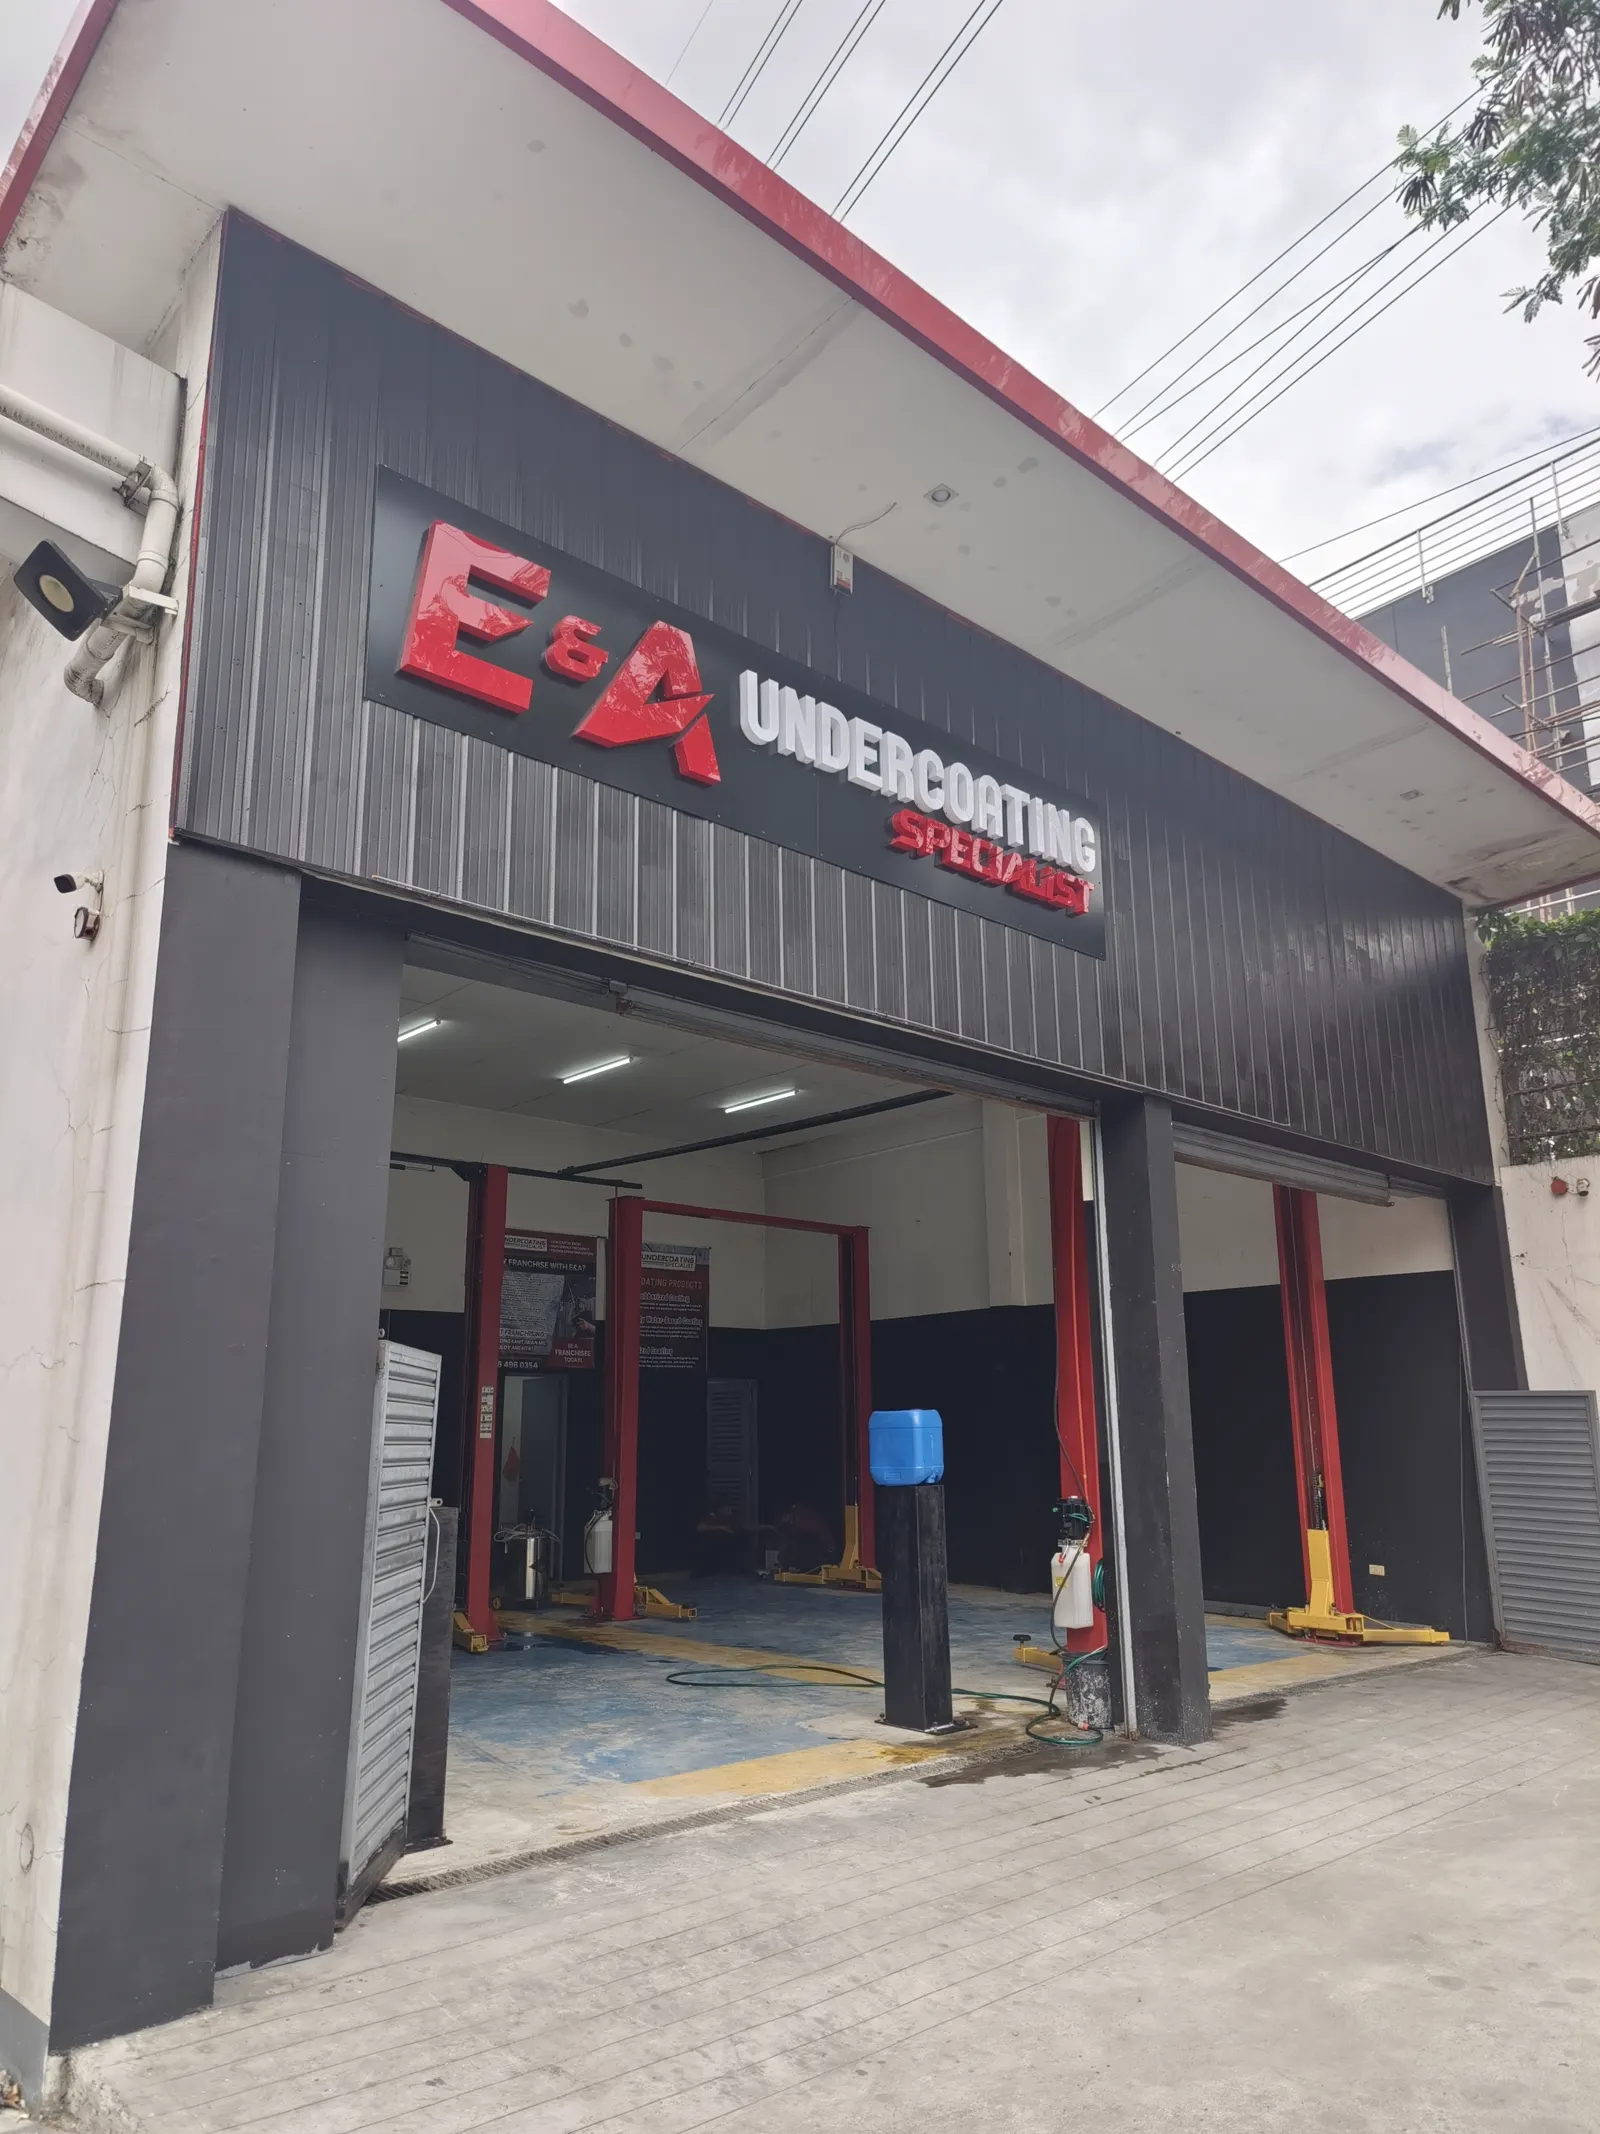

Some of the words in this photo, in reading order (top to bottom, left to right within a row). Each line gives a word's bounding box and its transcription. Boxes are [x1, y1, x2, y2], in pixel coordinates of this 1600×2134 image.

[739, 669, 1096, 875] UNDERCOATING
[889, 808, 1095, 918] SPECIALIST
[504, 1237, 546, 1246] NDERCOATING
[641, 1254, 694, 1264] UNDERCOATING
[508, 1258, 549, 1269] FRANCHISE
[550, 1262, 568, 1271] WITH
[569, 1263, 587, 1272] E&A?
[665, 1261, 694, 1269] SPECIALIST
[640, 1277, 667, 1287] OATING
[668, 1279, 703, 1290] PRODUCTS
[640, 1292, 669, 1301] ubberized
[554, 1348, 592, 1357] FRANCHISEE
